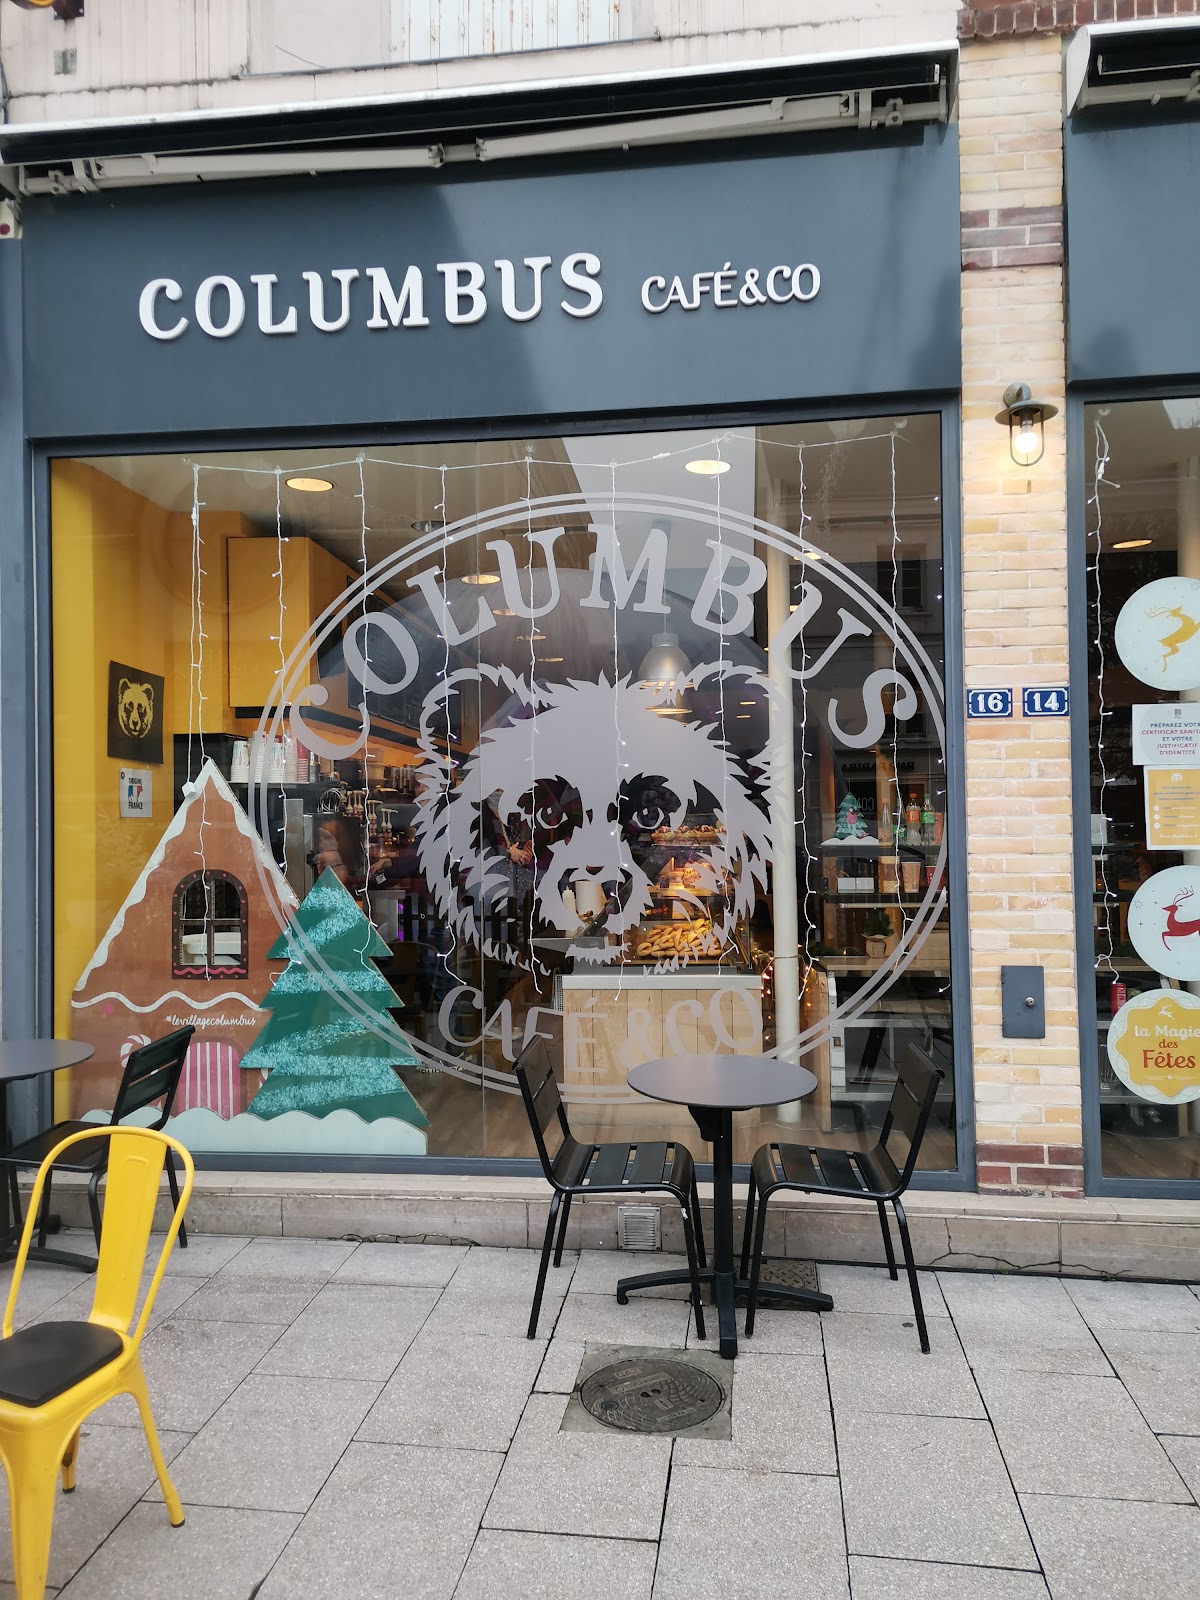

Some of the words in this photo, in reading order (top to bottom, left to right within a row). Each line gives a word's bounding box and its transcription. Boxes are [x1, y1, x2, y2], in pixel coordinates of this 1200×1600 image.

[138, 252, 604, 341] COLUMBUS
[640, 262, 822, 315] CAFÉ&CO
[289, 524, 918, 760] COLUMBUS
[977, 693, 1004, 713] 16
[1033, 692, 1060, 712] 14
[128, 801, 143, 809] FRANCE
[1134, 1025, 1151, 1037] la
[1155, 1024, 1200, 1041] Magie
[1158, 1039, 1179, 1049] des
[1142, 1049, 1197, 1069] Fêtes
